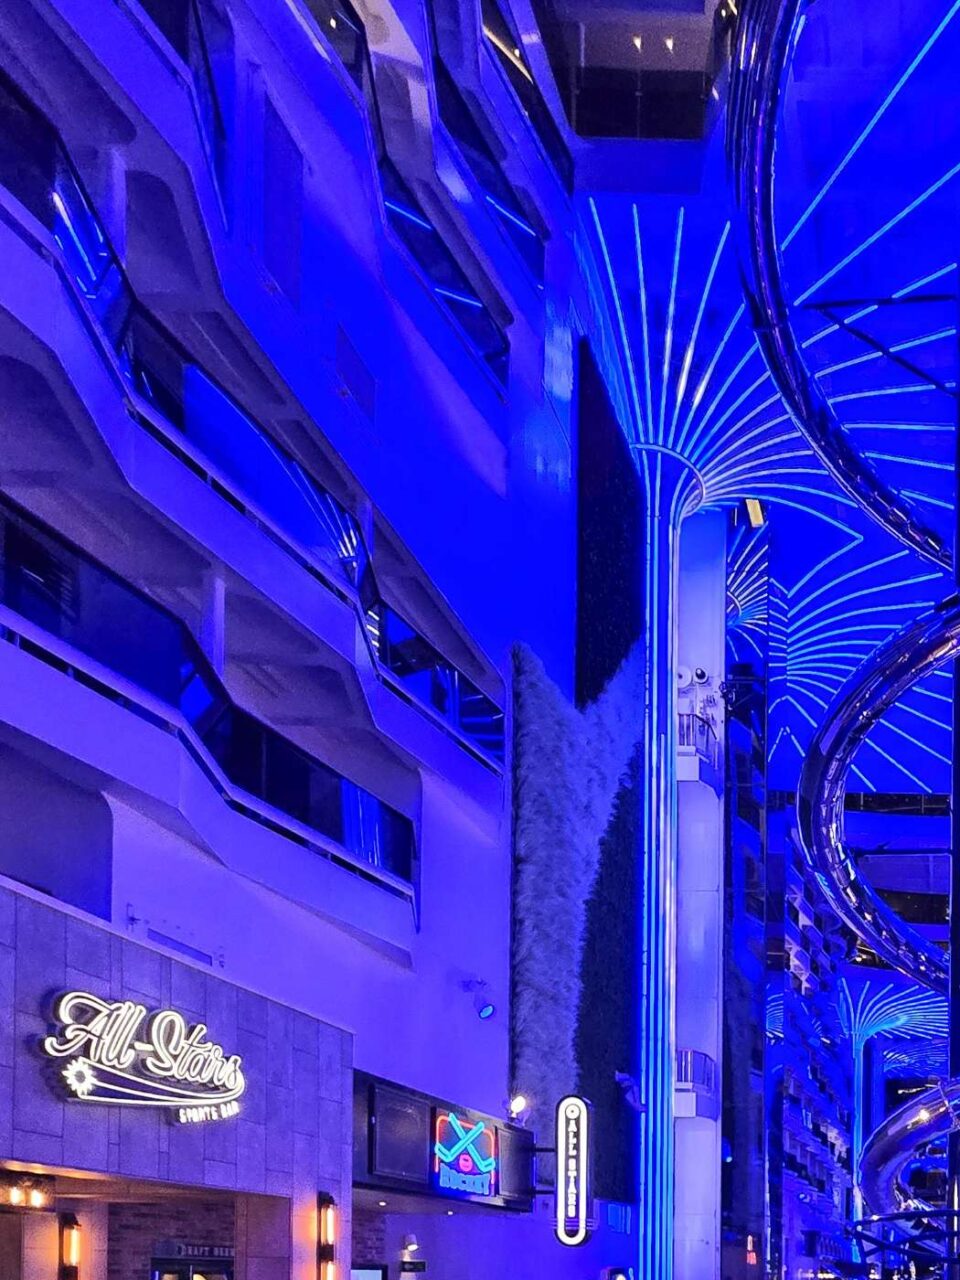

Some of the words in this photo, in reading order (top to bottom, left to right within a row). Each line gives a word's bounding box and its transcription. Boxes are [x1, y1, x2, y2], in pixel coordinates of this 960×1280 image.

[44, 991, 242, 1090] All-Stars
[179, 1106, 218, 1123] SPORTS
[220, 1101, 239, 1118] BAR
[568, 1120, 577, 1156] ALL
[440, 1162, 490, 1195] HOCKEY
[567, 1158, 577, 1218] STARS
